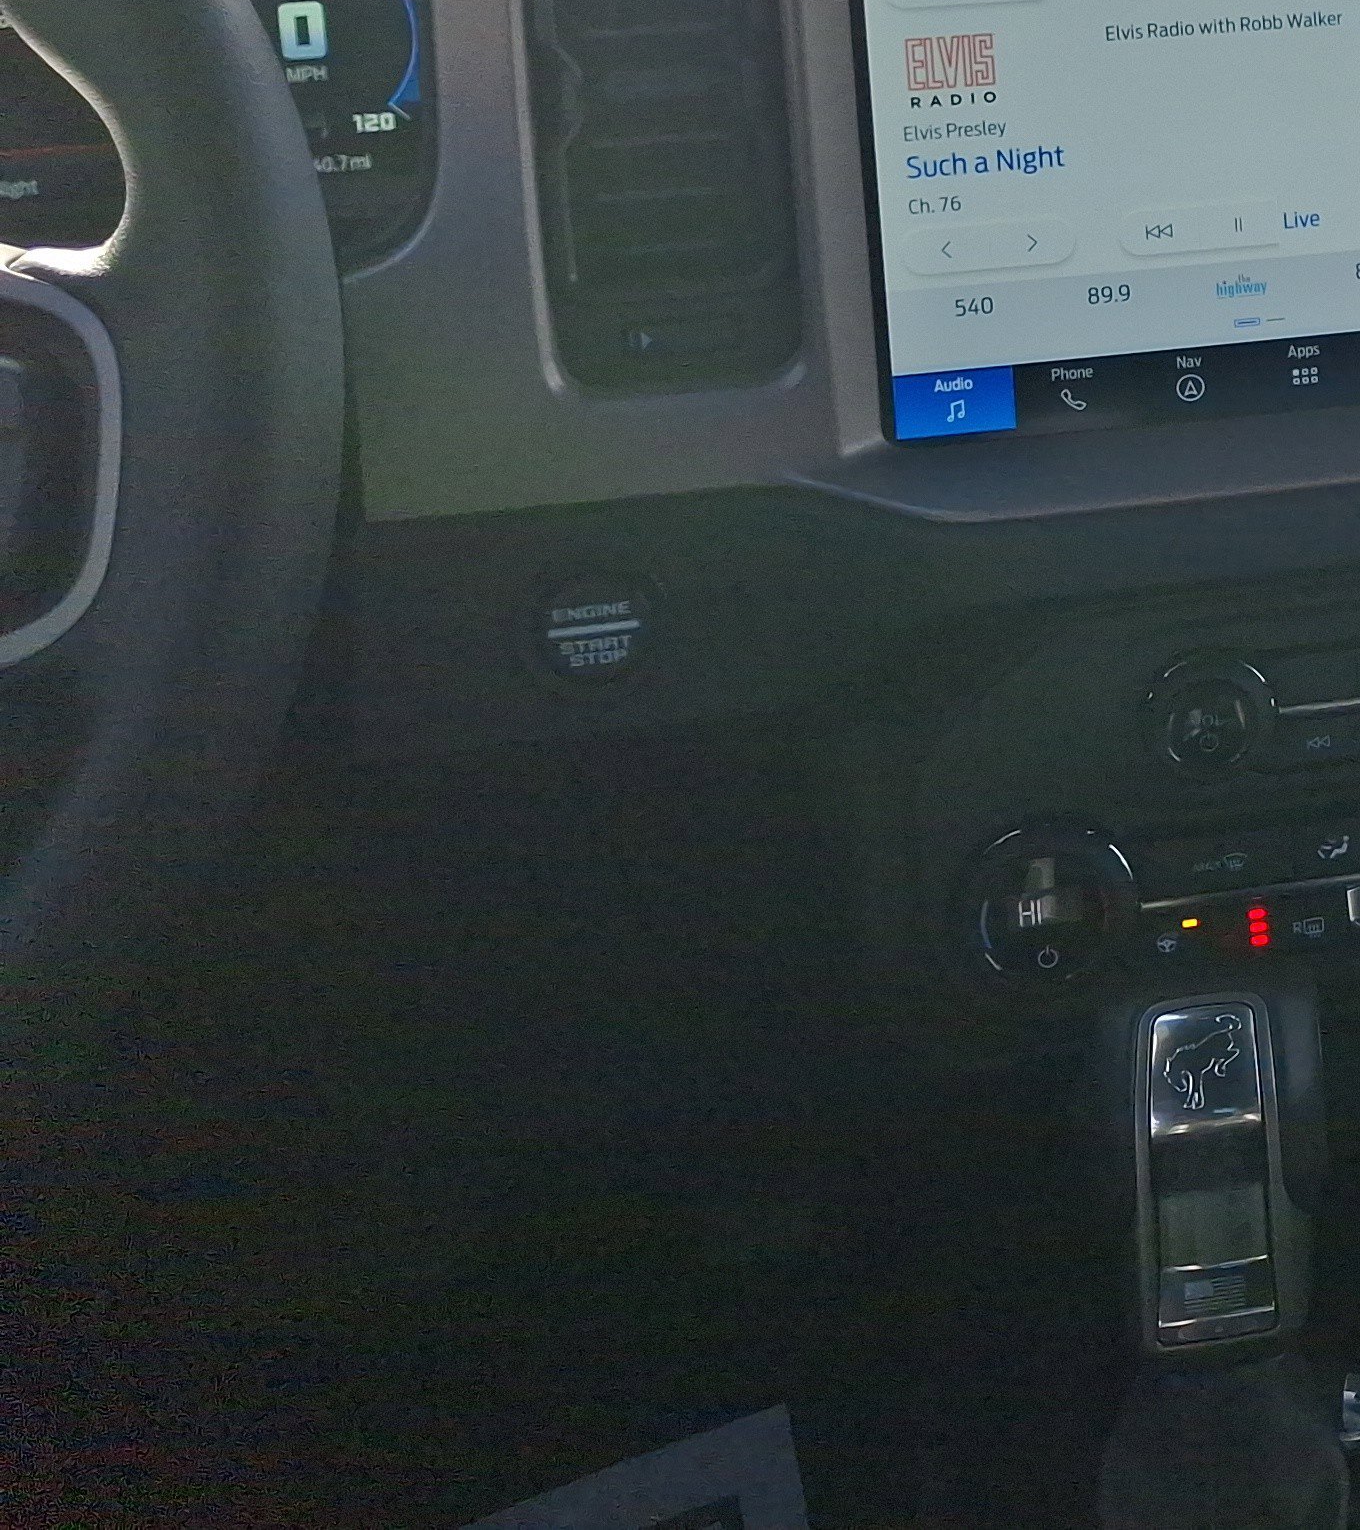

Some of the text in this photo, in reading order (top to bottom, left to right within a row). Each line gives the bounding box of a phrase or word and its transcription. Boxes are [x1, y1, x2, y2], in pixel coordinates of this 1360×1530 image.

[277, 1, 328, 61] 0
[1105, 10, 1343, 42] Elvis Radio with Robb Walker
[905, 33, 996, 91] ELVIS
[286, 66, 328, 82] MPH
[910, 91, 997, 108] RADIO
[352, 112, 397, 132] 120
[903, 120, 1007, 143] Elvis Presley
[907, 146, 1065, 180] Such a Night
[908, 195, 962, 215] Ch. 76
[1283, 210, 1321, 230] Live
[1087, 285, 1132, 305] 89.9
[1215, 278, 1268, 299] highway
[954, 296, 994, 316] 540
[1287, 343, 1321, 360] Apps
[1176, 355, 1202, 370] Nav
[1050, 365, 1094, 381] Phone
[934, 377, 974, 392] Audio
[552, 601, 631, 622] ENGINE
[559, 635, 632, 655] START
[569, 649, 628, 667] STOP
[1018, 900, 1043, 926] HI
